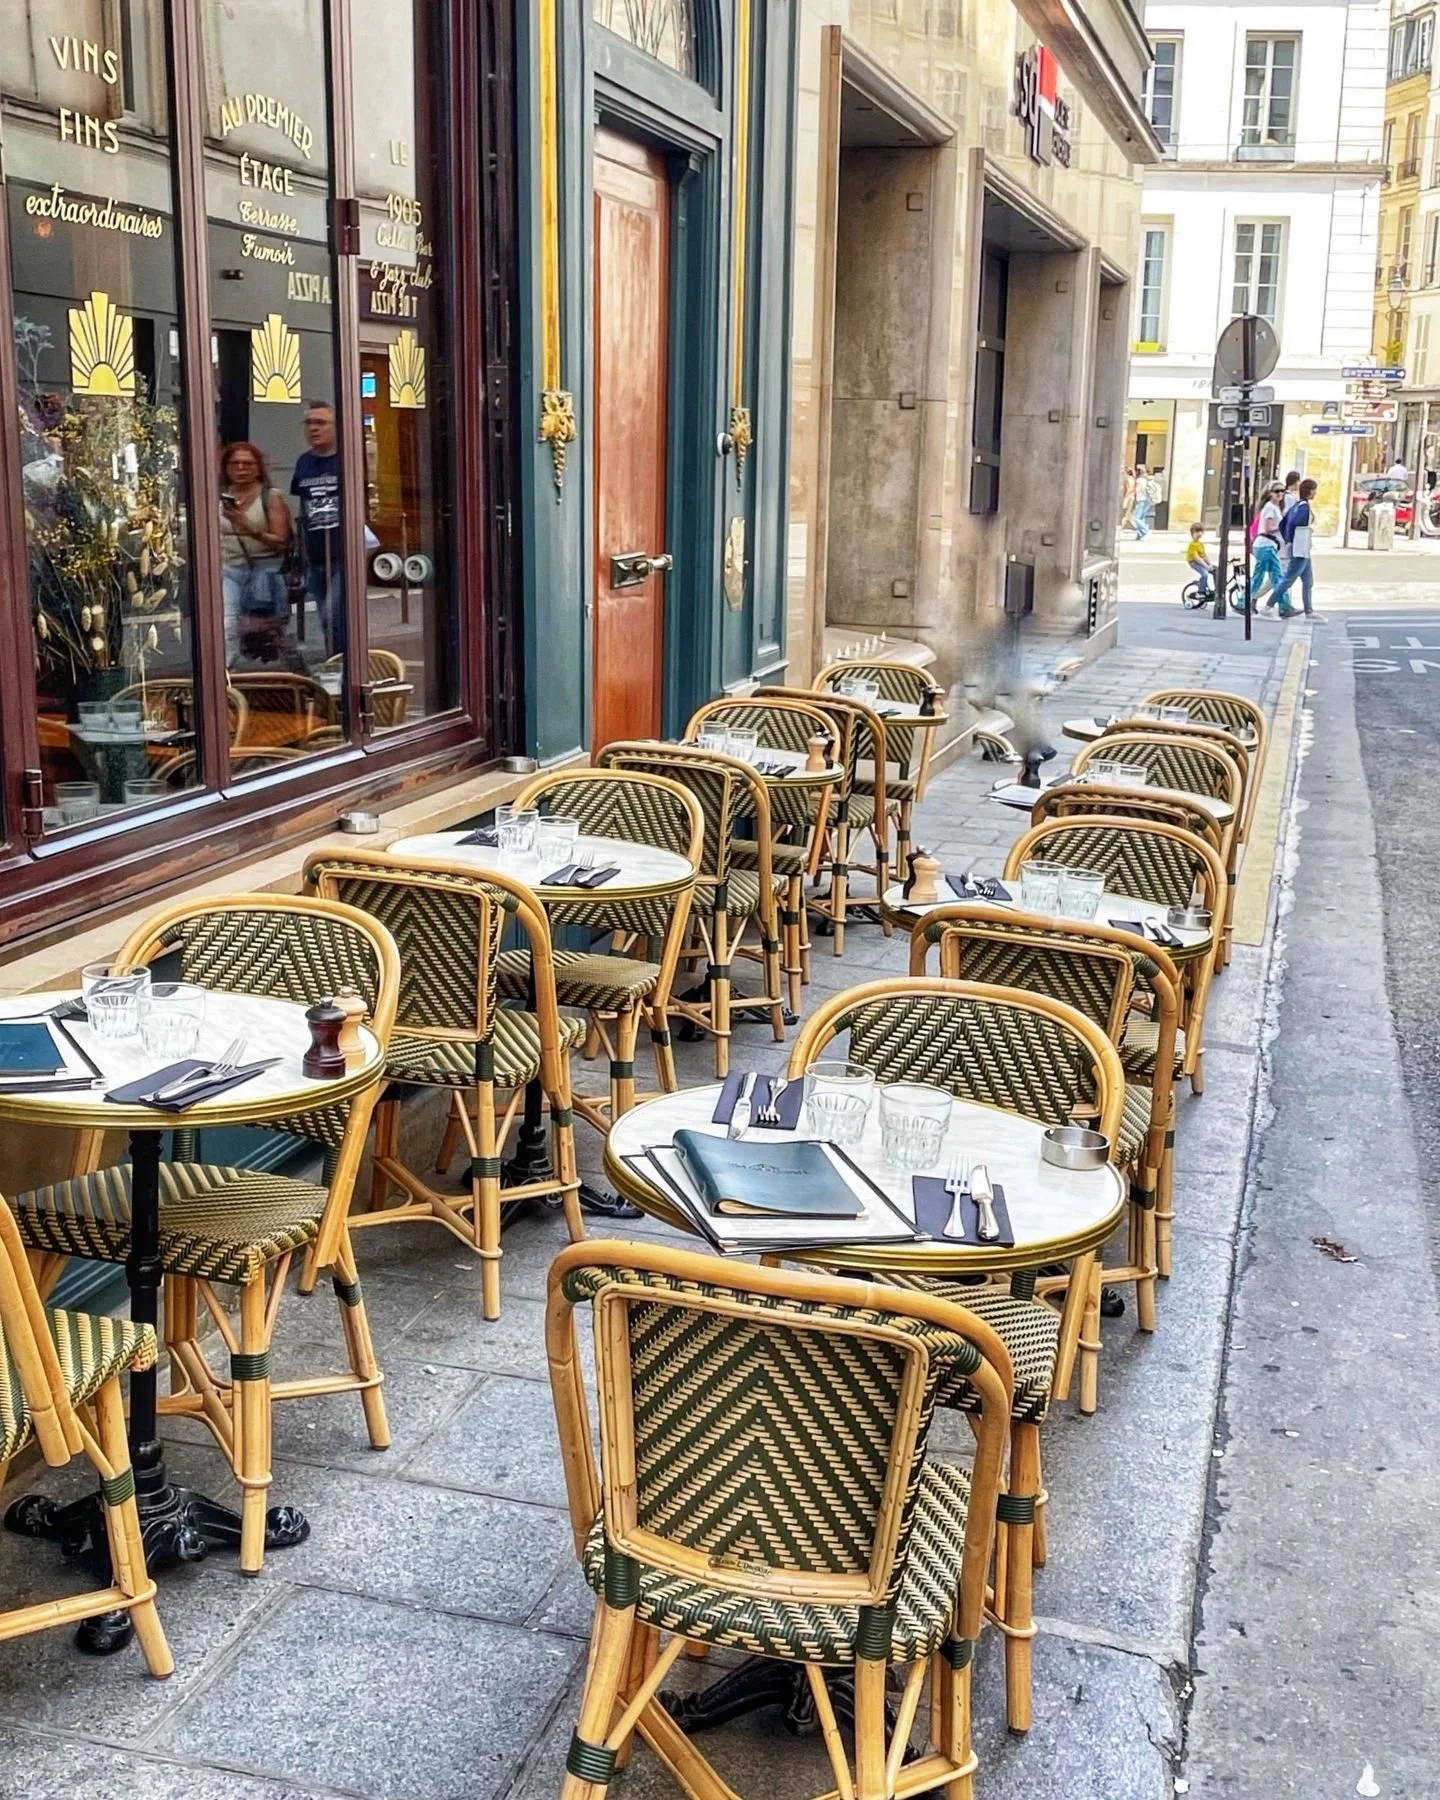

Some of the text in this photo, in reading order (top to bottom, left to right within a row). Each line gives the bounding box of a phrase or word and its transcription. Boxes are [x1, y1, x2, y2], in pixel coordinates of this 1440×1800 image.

[51, 36, 119, 84] VINS
[60, 107, 120, 154] FINS
[221, 94, 313, 159] AU PREMIER
[240, 152, 295, 196] ÉTAGE
[390, 140, 409, 167] LE
[26, 182, 163, 238] extraordinaires
[240, 201, 300, 236] Terrasse,
[386, 193, 422, 226] 1905
[242, 234, 296, 266] Fumoir
